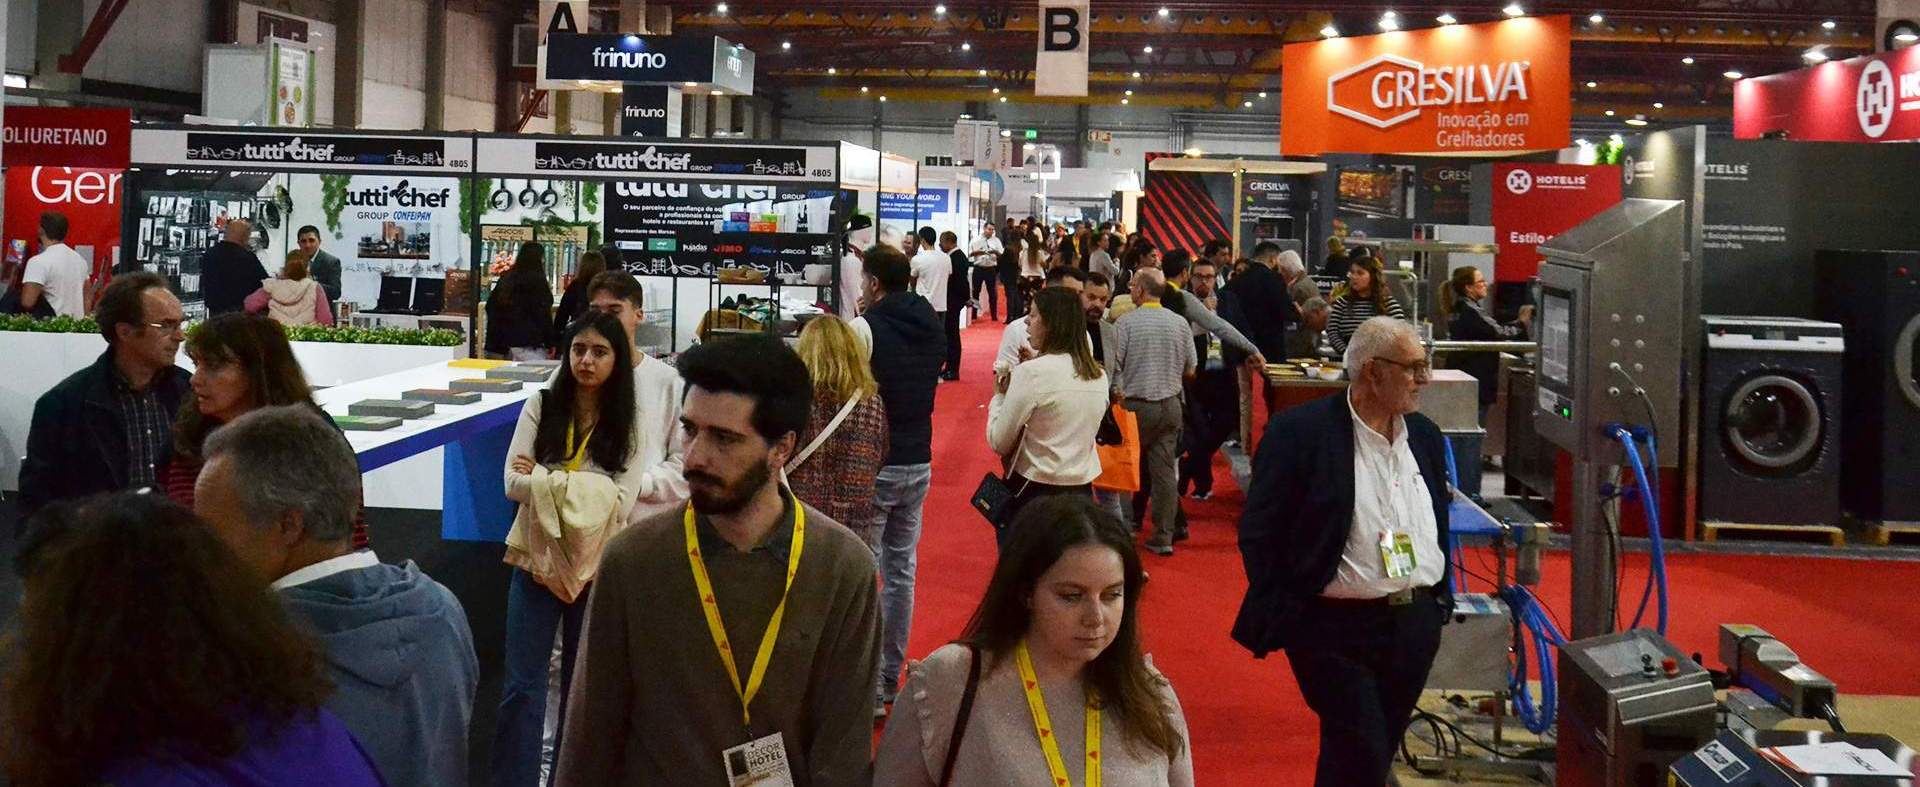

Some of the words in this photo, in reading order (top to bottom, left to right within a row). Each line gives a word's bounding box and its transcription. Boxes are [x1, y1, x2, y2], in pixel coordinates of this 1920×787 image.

[1044, 7, 1081, 51] B
[592, 47, 666, 69] frinuno
[1371, 62, 1528, 109] GRESILVA
[625, 105, 665, 119] frinuno
[1437, 111, 1500, 130] Inovação
[1505, 112, 1529, 126] em
[1436, 130, 1525, 148] Grelhadores
[243, 141, 285, 160] tutti
[290, 143, 335, 161] chef
[595, 150, 639, 169] tutti
[645, 152, 691, 171] chef
[1536, 174, 1587, 185] HOTELIS
[397, 187, 450, 207] chef
[357, 211, 390, 220] GROUP
[1510, 231, 1545, 244] Estilo
[747, 742, 780, 760] DECOR
[750, 751, 783, 769] HOTEL
